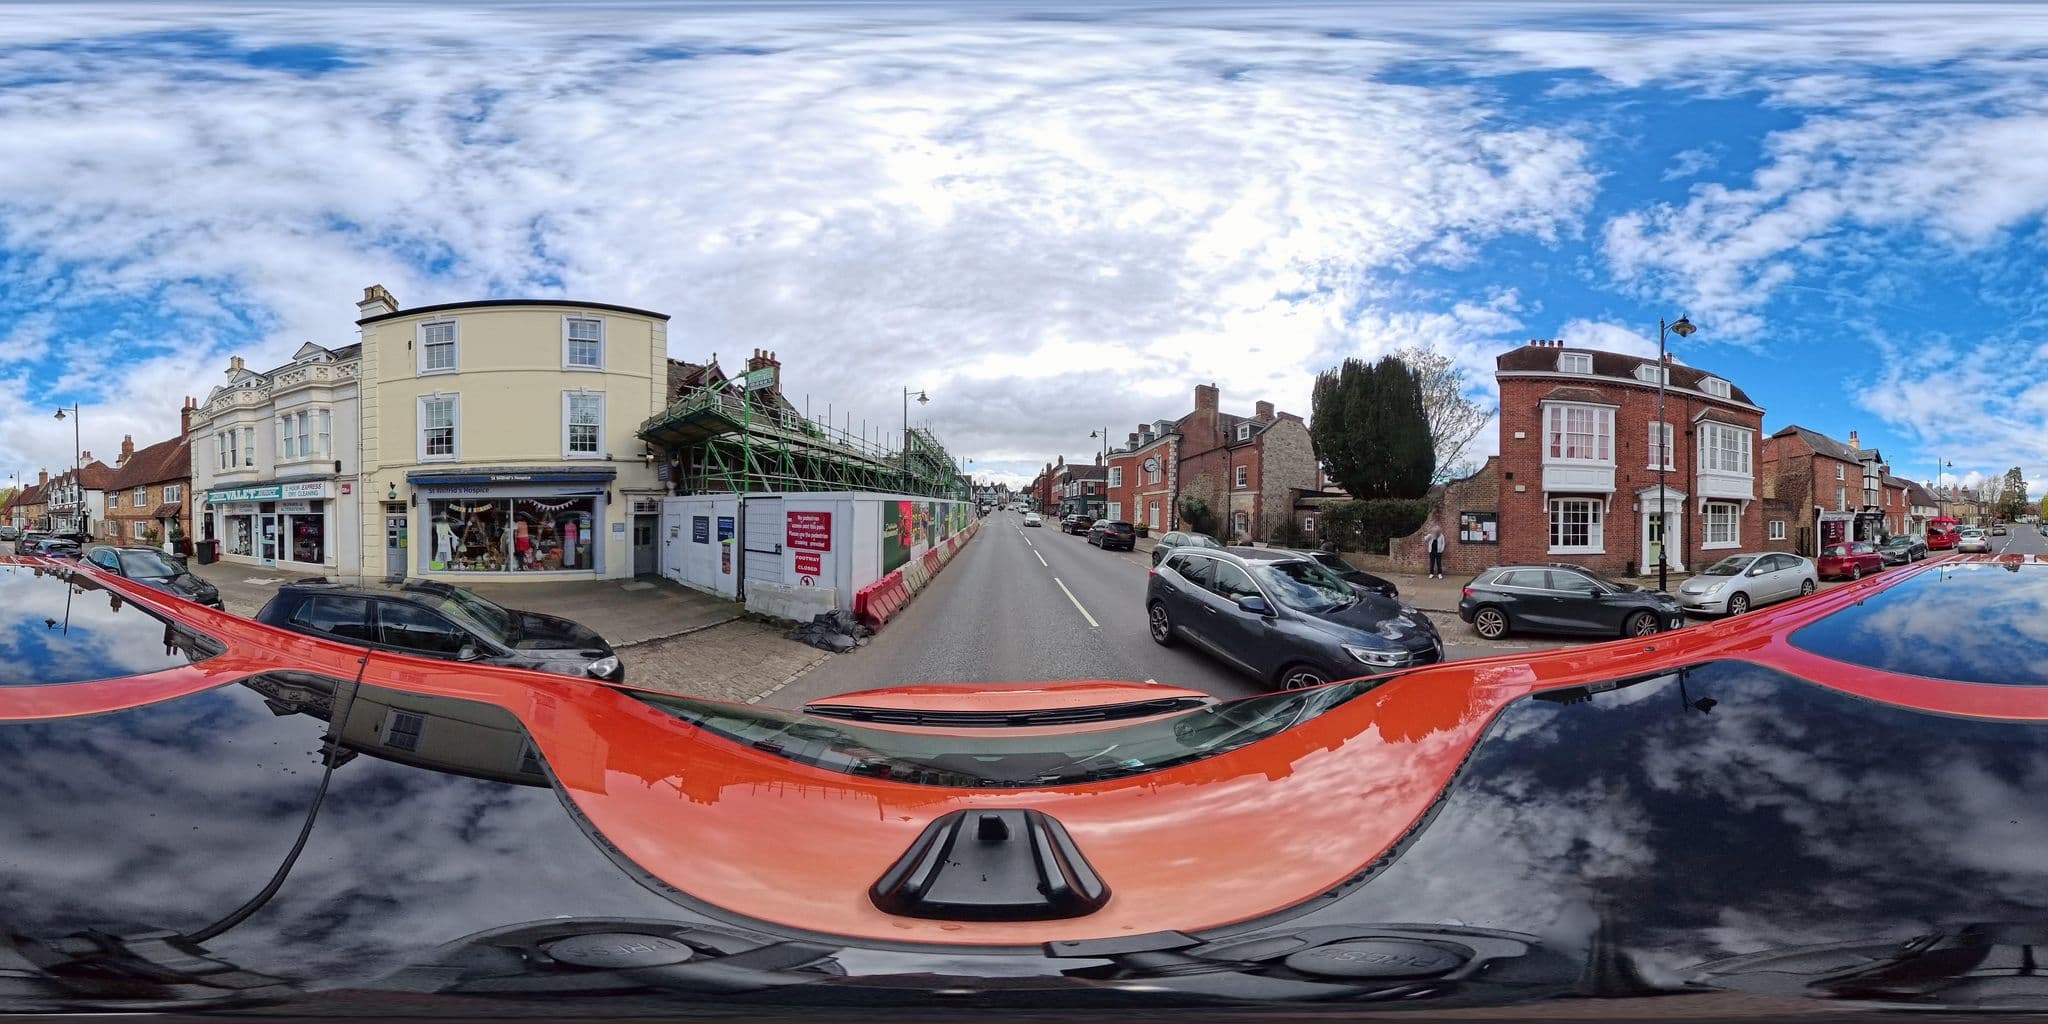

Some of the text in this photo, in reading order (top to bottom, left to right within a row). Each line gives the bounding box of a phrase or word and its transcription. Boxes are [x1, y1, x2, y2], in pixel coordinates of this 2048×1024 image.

[302, 483, 322, 491] EXPRESS
[464, 487, 490, 495] Hospice
[224, 488, 256, 500] VALET
[797, 564, 818, 572] CLOSED
